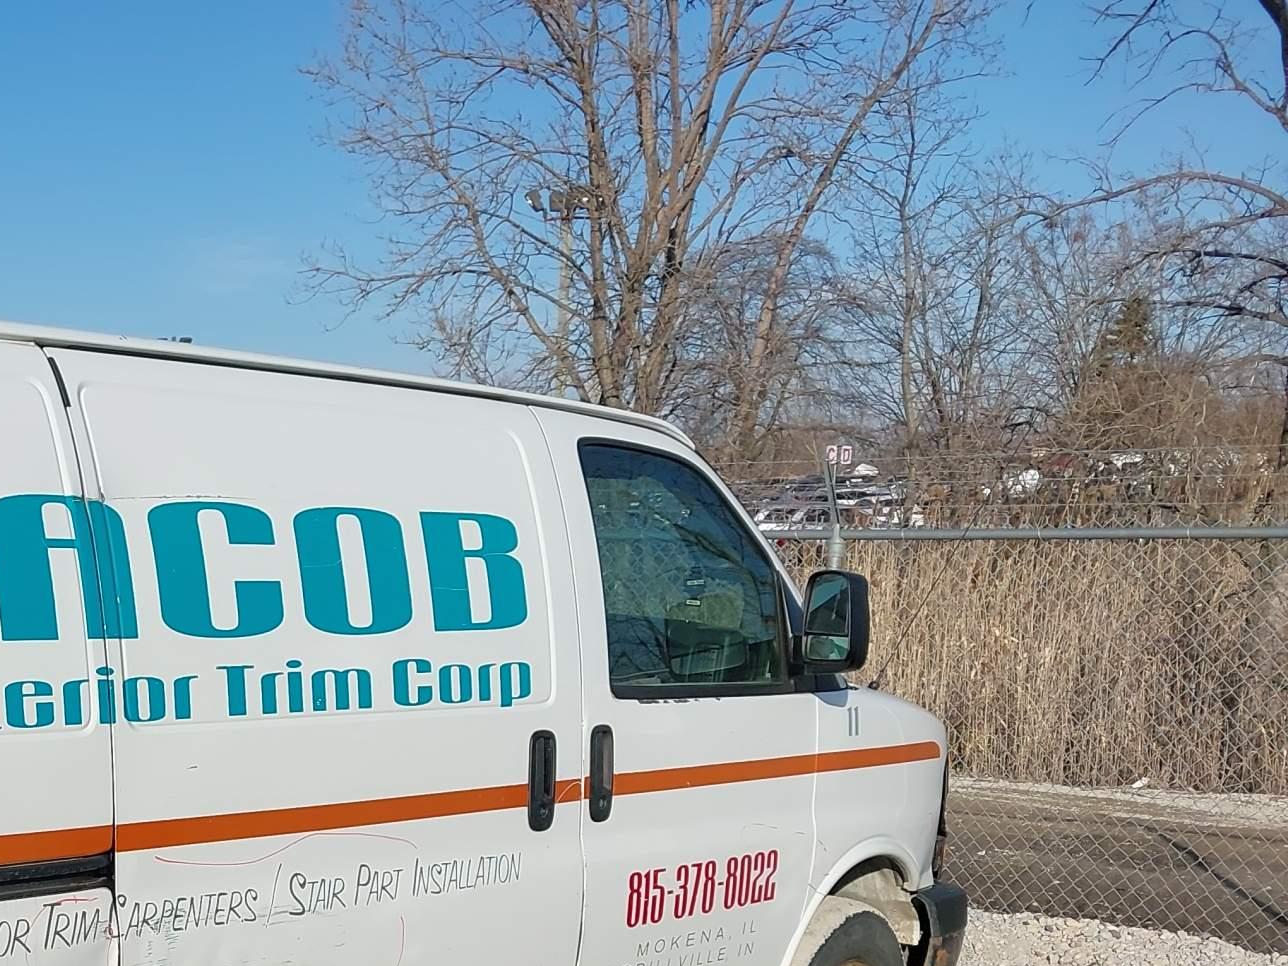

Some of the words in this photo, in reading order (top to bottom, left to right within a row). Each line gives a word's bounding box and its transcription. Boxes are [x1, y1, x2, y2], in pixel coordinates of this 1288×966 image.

[216, 659, 373, 718] Trim
[393, 657, 532, 707] Corp
[43, 902, 100, 950] TRIM
[108, 888, 259, 940] CARPENTERS
[288, 872, 347, 917] STAIR
[354, 863, 404, 907] PART
[412, 851, 523, 898] INSTALLATION
[626, 849, 779, 928] 815-378-8022
[636, 926, 732, 958] MOKENA,
[742, 919, 757, 936] IL
[737, 942, 755, 957] IN
